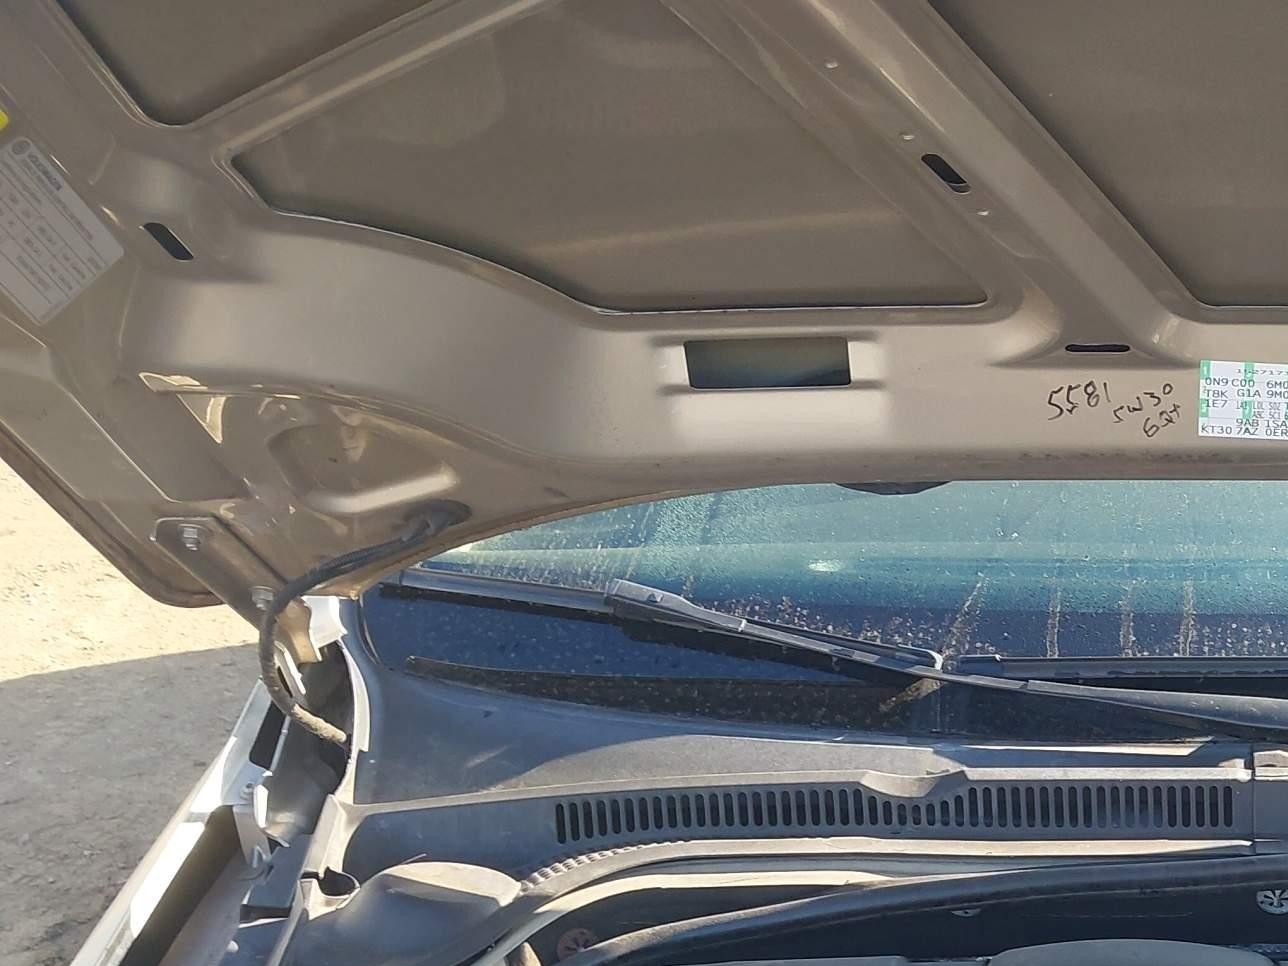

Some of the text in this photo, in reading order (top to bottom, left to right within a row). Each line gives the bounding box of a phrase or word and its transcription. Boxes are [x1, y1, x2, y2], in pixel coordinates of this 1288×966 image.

[1237, 388, 1262, 398] G1A
[1205, 399, 1228, 408] 1E7
[1201, 424, 1233, 435] KT30
